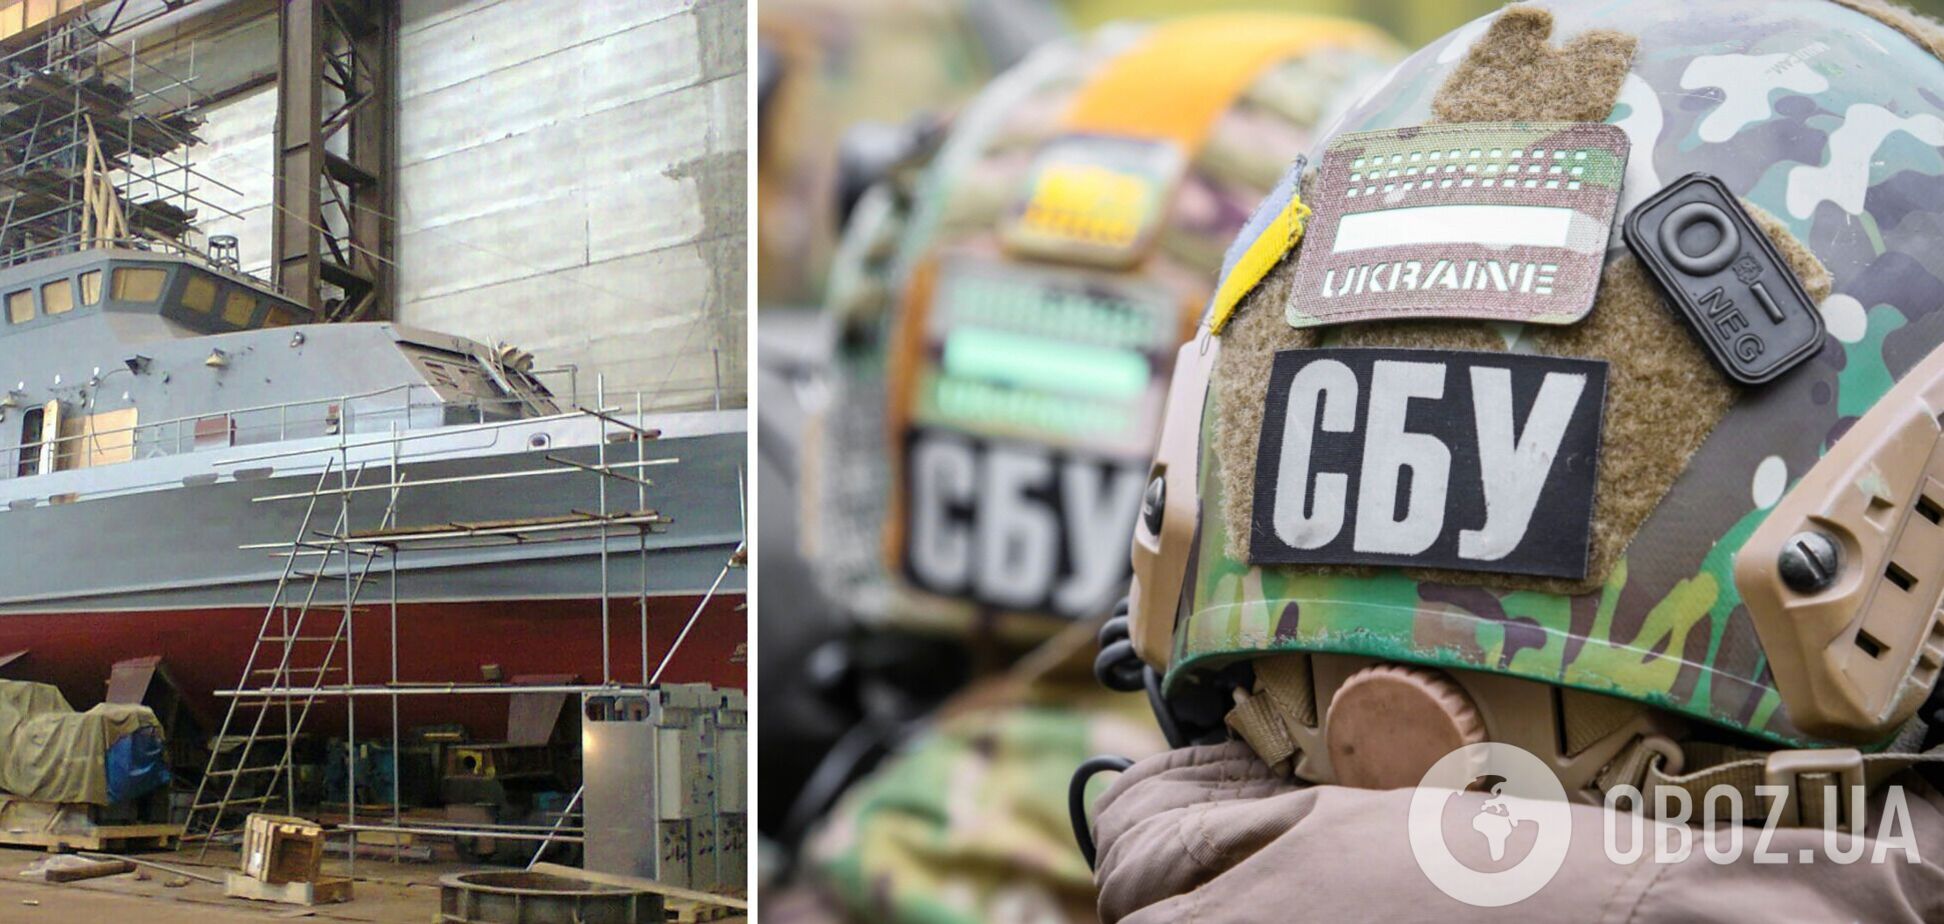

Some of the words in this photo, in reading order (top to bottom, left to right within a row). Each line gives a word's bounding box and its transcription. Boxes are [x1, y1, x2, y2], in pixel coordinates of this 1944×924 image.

[1322, 258, 1559, 298] UKRAINE
[1697, 285, 1764, 365] NEG
[1273, 358, 1588, 562] СБУ
[910, 441, 1144, 617] СБУ
